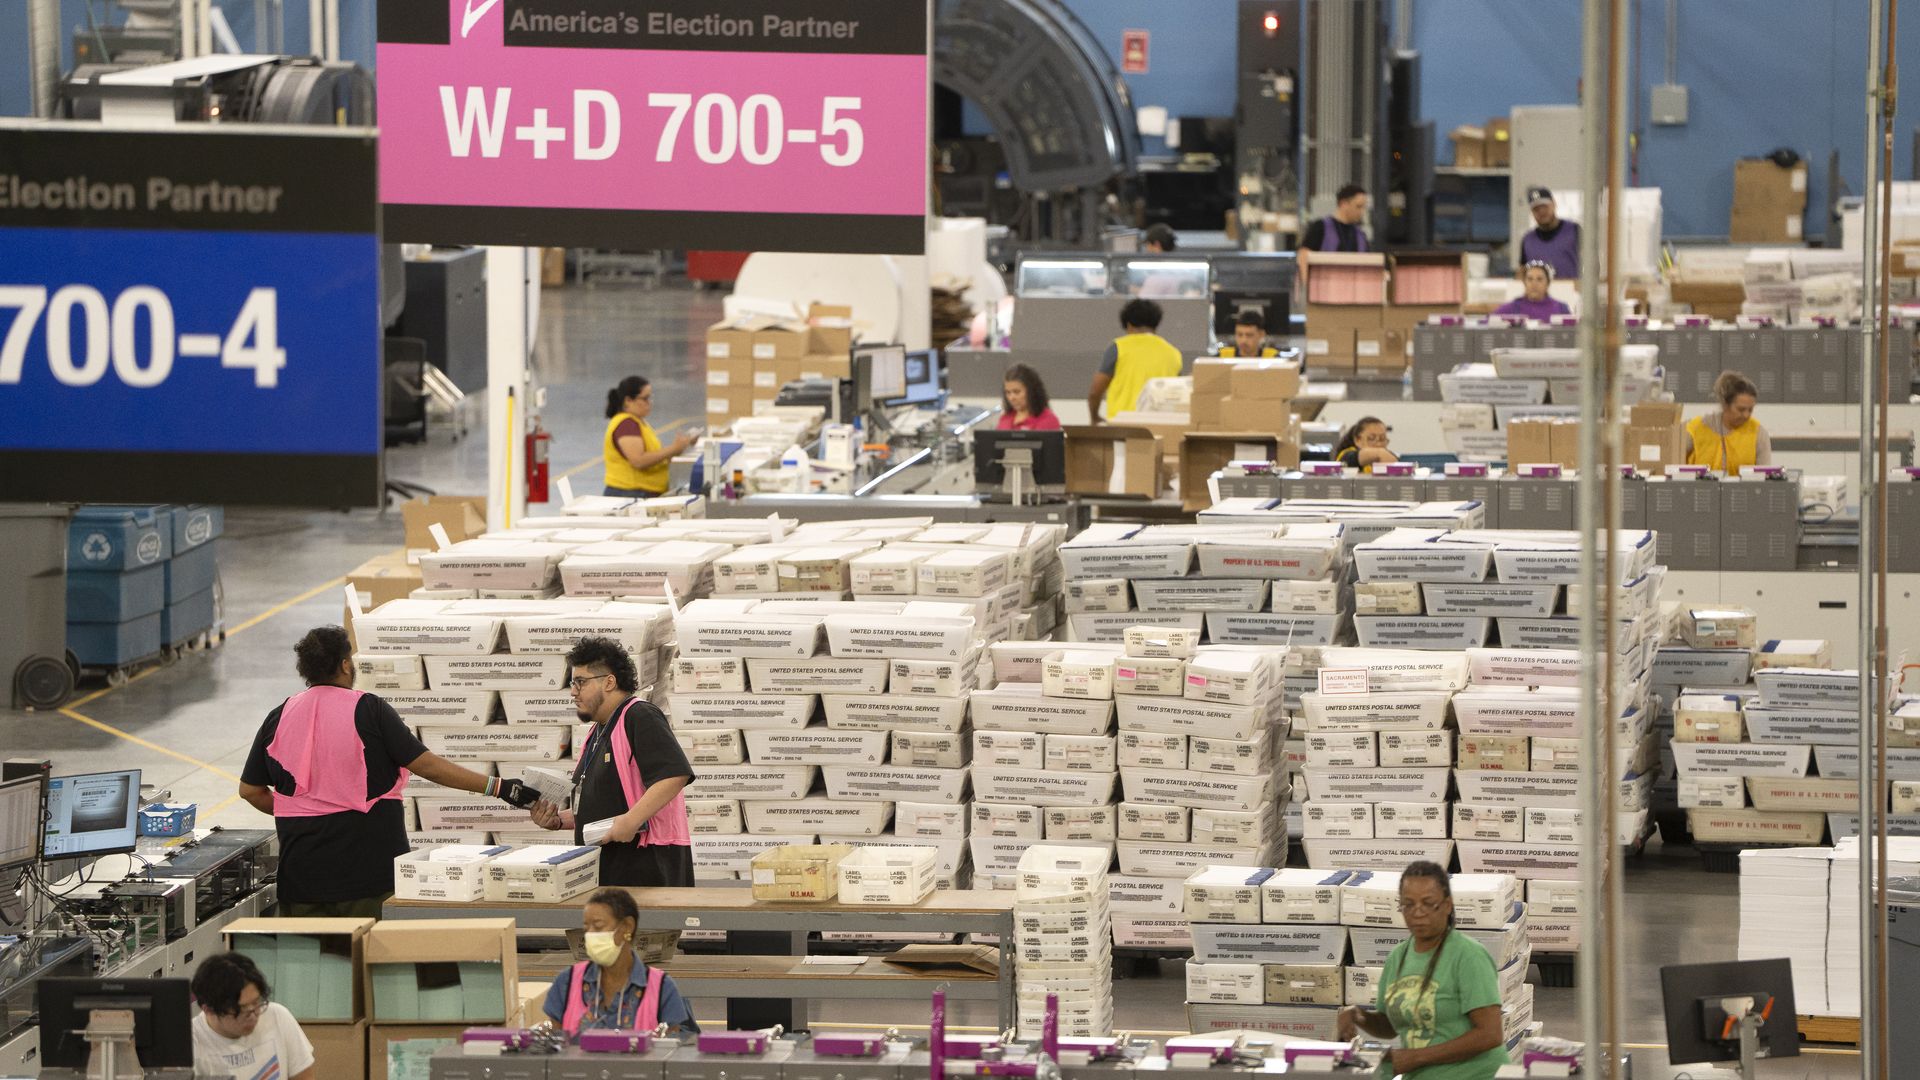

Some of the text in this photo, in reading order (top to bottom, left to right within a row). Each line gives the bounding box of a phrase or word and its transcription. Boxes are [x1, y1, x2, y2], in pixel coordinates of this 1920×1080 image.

[510, 9, 859, 38] America’s Election Partner
[439, 85, 864, 166] W+D 700-5
[146, 176, 283, 213] Partner
[0, 284, 287, 388] 700-4
